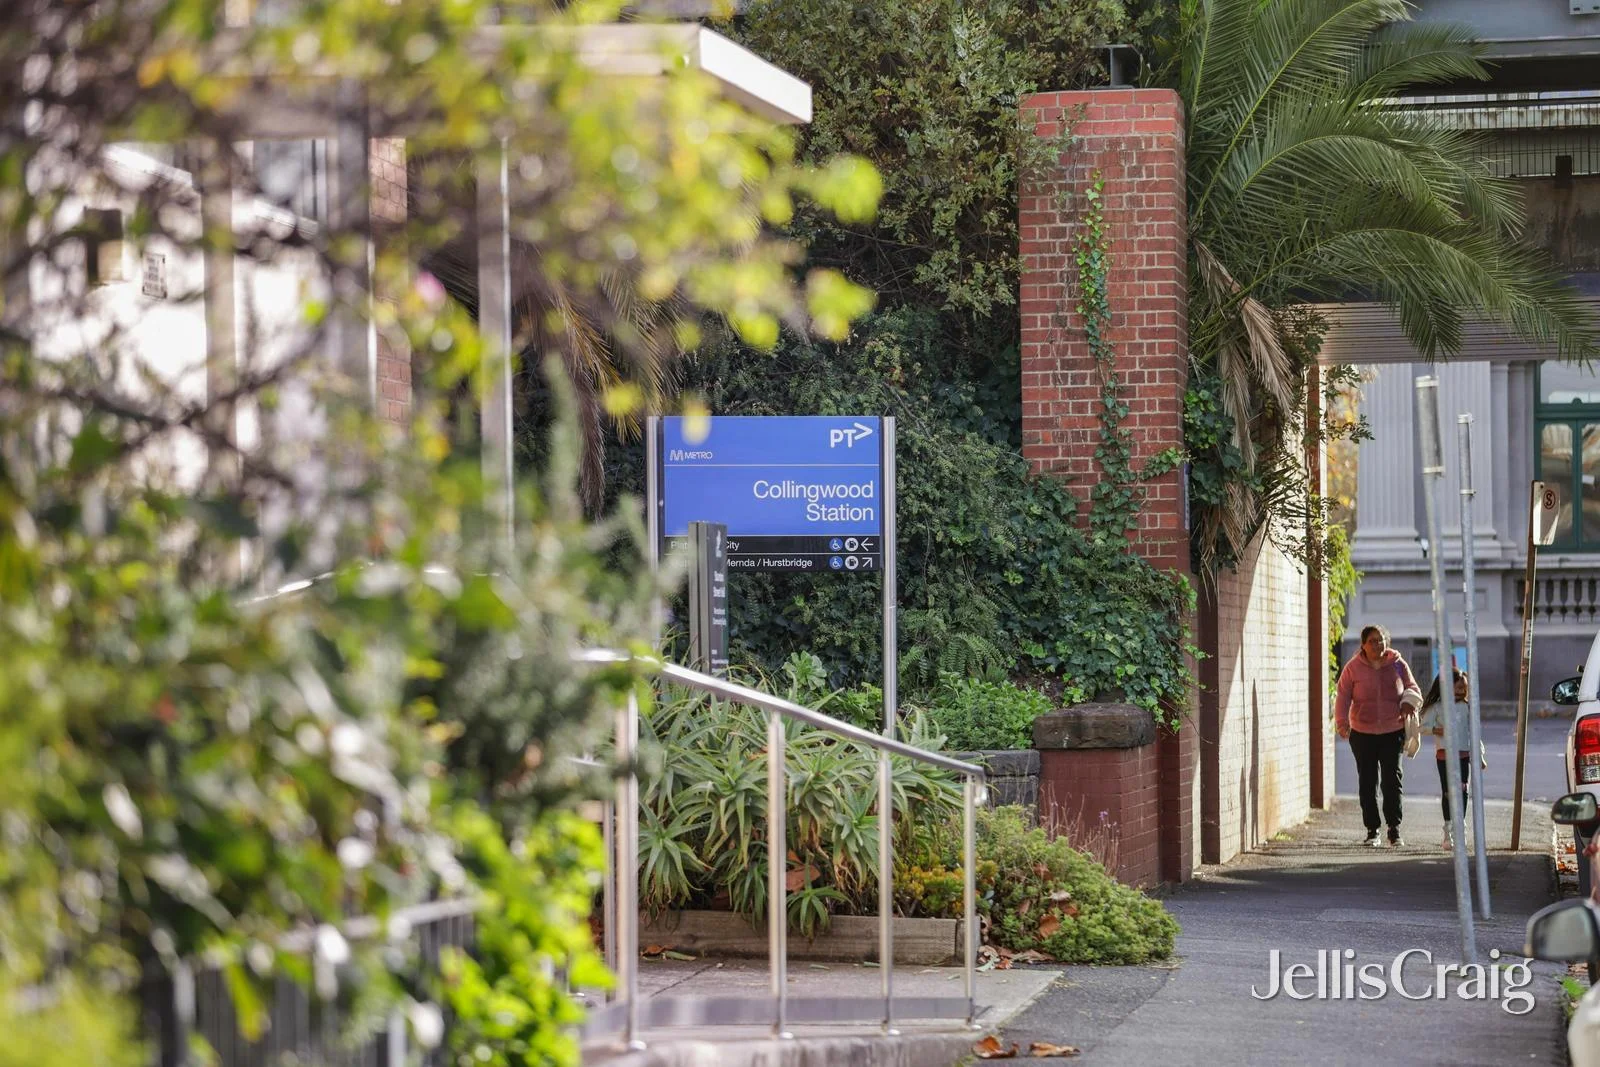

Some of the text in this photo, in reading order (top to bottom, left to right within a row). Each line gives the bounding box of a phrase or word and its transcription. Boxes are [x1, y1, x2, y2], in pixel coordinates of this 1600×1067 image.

[752, 480, 874, 502] Collingwood
[806, 503, 874, 522] Station
[762, 559, 814, 569] Hurstbridge
